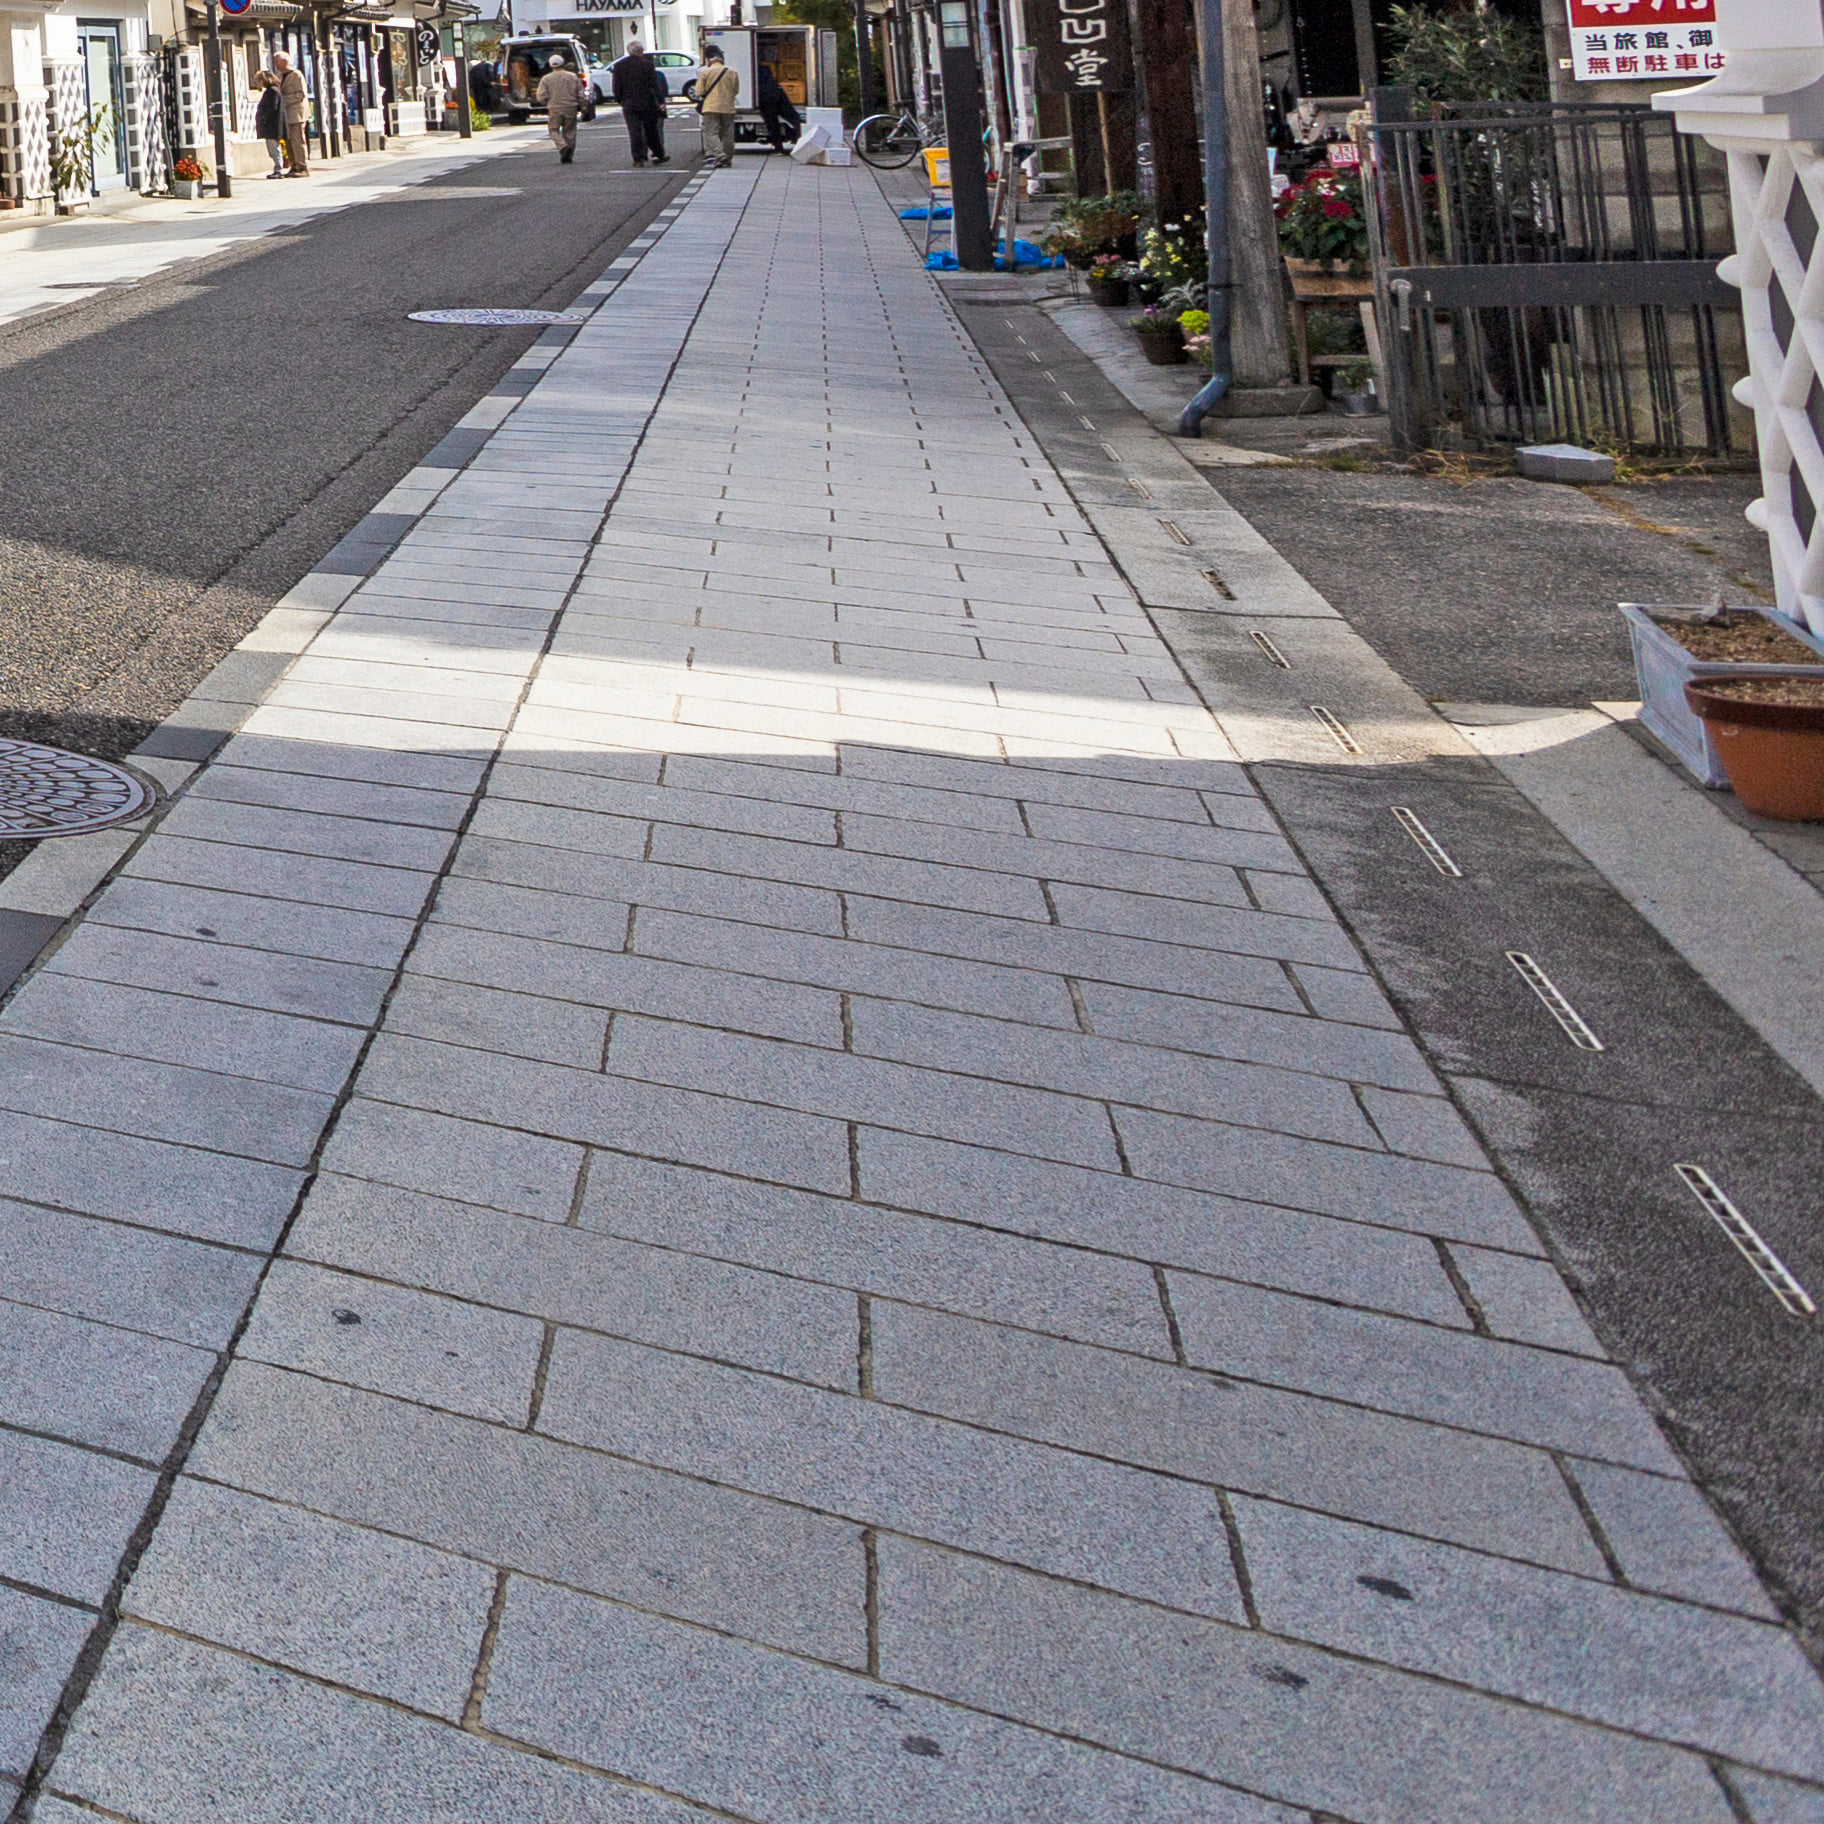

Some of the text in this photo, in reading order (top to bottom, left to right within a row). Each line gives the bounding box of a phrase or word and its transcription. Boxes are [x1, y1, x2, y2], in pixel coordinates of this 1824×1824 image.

[1585, 29, 1713, 52] 当旅館、御
[1587, 52, 1726, 75] 無断駐車は
